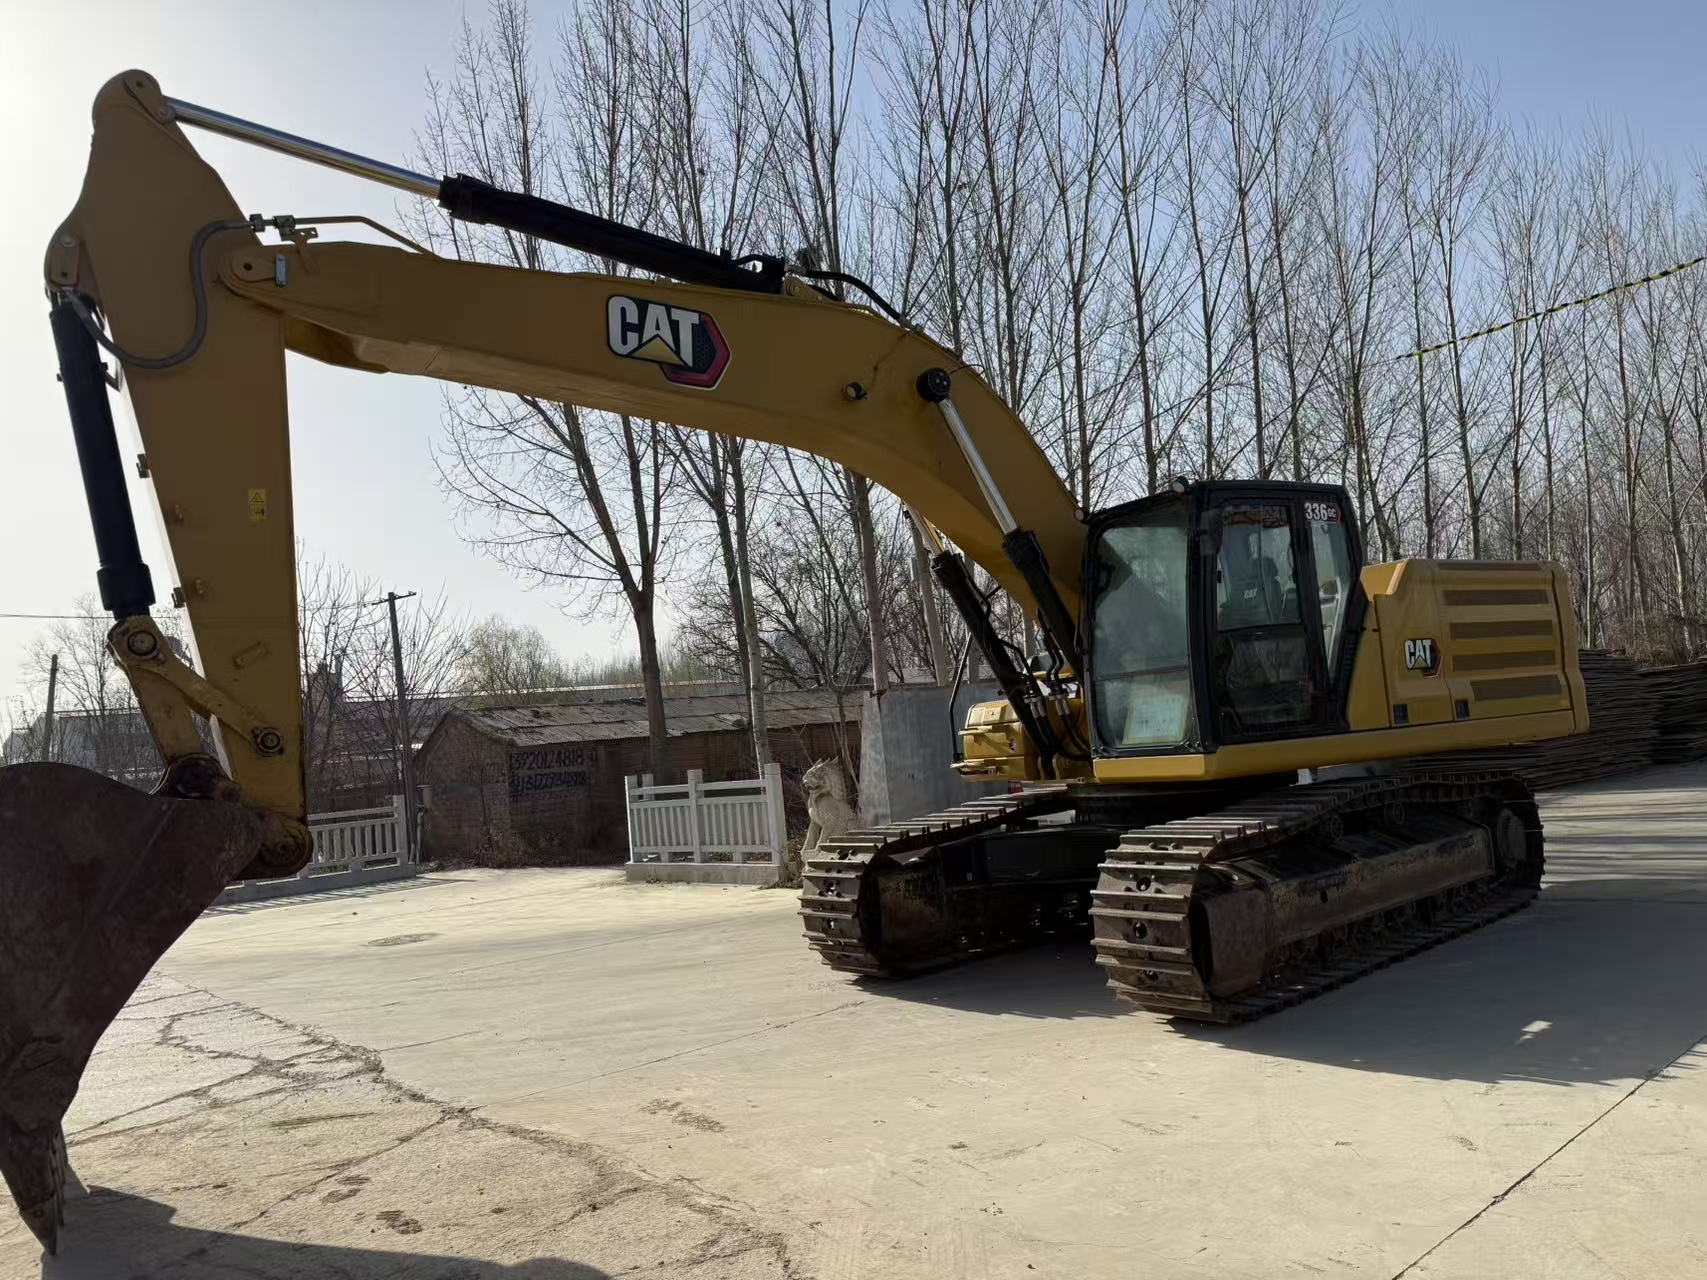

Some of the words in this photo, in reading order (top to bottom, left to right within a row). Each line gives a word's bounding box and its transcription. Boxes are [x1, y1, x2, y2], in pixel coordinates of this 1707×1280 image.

[607, 295, 699, 367] CAT
[1304, 502, 1328, 521] 336
[1404, 639, 1432, 669] CAT
